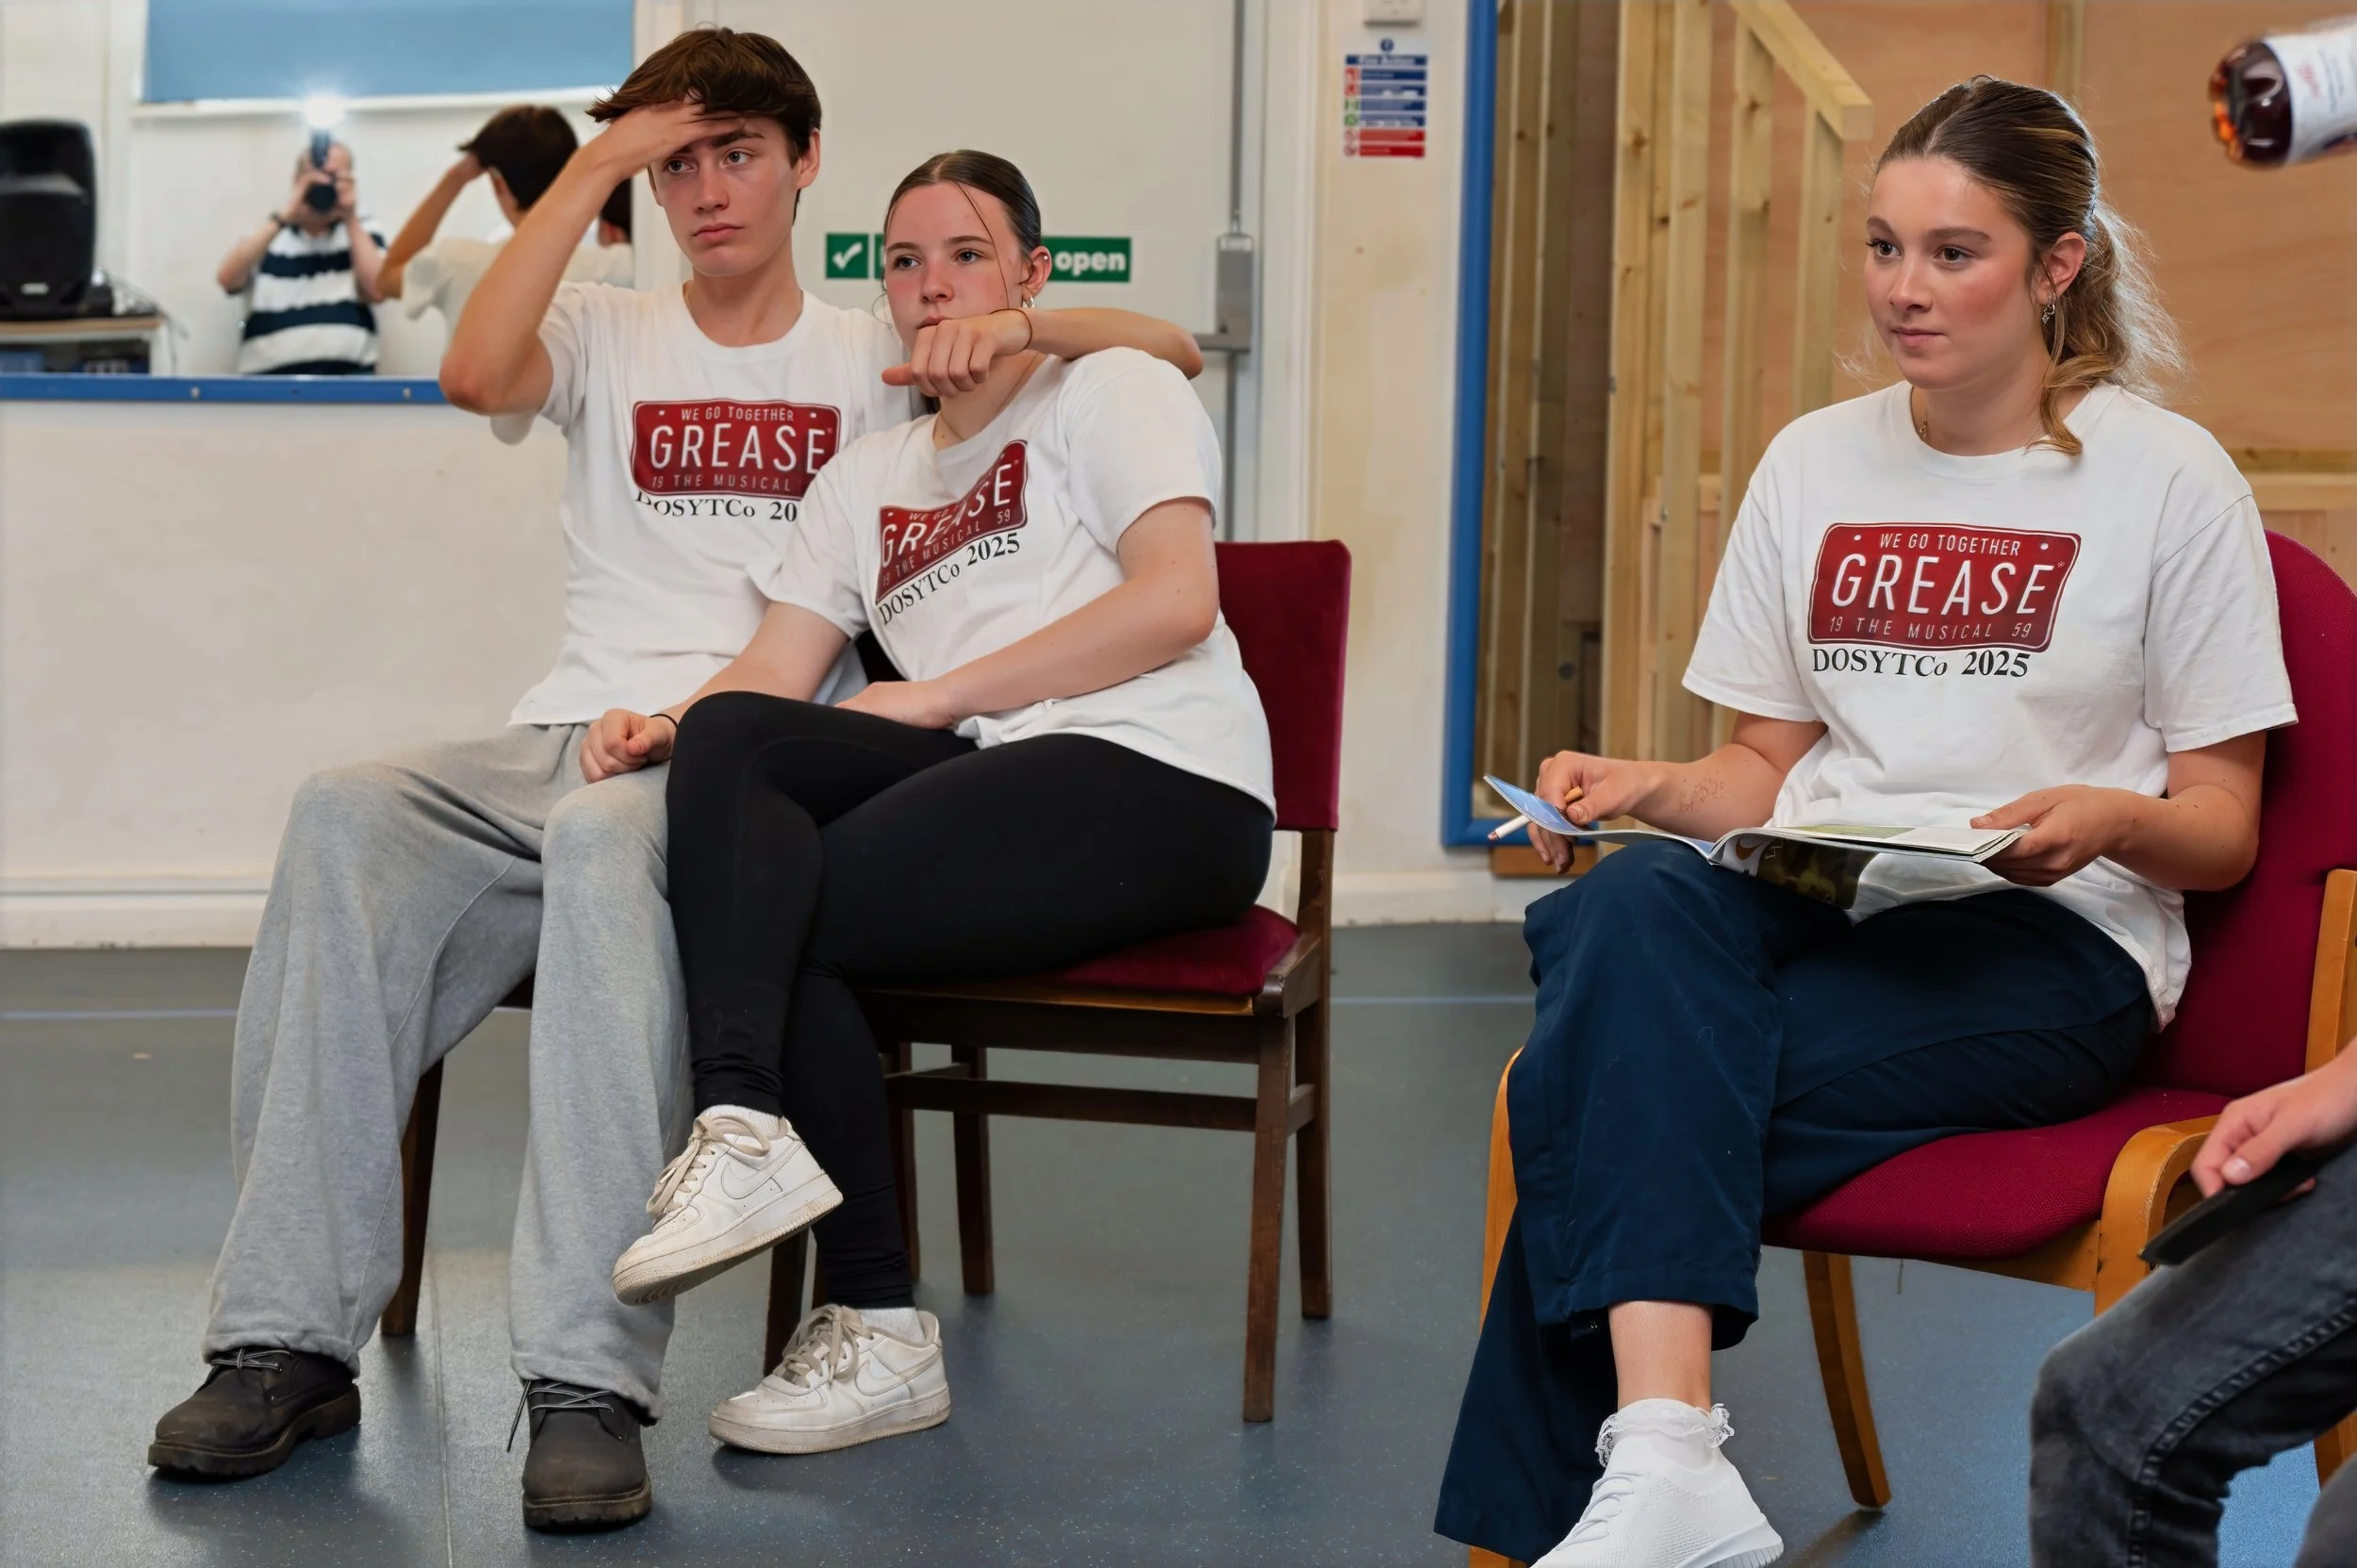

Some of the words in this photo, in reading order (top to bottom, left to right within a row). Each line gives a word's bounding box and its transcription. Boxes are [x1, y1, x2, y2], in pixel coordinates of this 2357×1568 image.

[1054, 250, 1127, 276] open
[681, 407, 699, 421] WE
[705, 406, 721, 420] GO
[728, 406, 794, 422] TOGETHER
[651, 422, 826, 474] GREASE
[651, 475, 664, 488] 19
[674, 474, 702, 487] THE
[714, 474, 791, 491] MUSICAL
[769, 502, 798, 522] 20
[882, 463, 1013, 569] GREASE
[909, 512, 928, 521] WE
[896, 554, 915, 577] THE
[923, 520, 981, 560] MUSICAL
[997, 509, 1011, 524] 59
[1879, 533, 1901, 549] WE
[1907, 534, 1929, 550] GO
[1937, 535, 2020, 556] TOGETHER
[879, 563, 960, 625] DOSYTCo
[966, 532, 1020, 567] 2025
[1831, 553, 2054, 616] GREASE
[1829, 616, 1843, 633] 19
[1856, 618, 1893, 636] THE
[1907, 622, 1992, 640] MUSICAL
[2012, 622, 2033, 639] 59
[1812, 648, 1948, 677] DOSYTCo
[1961, 650, 2031, 678] 2025
